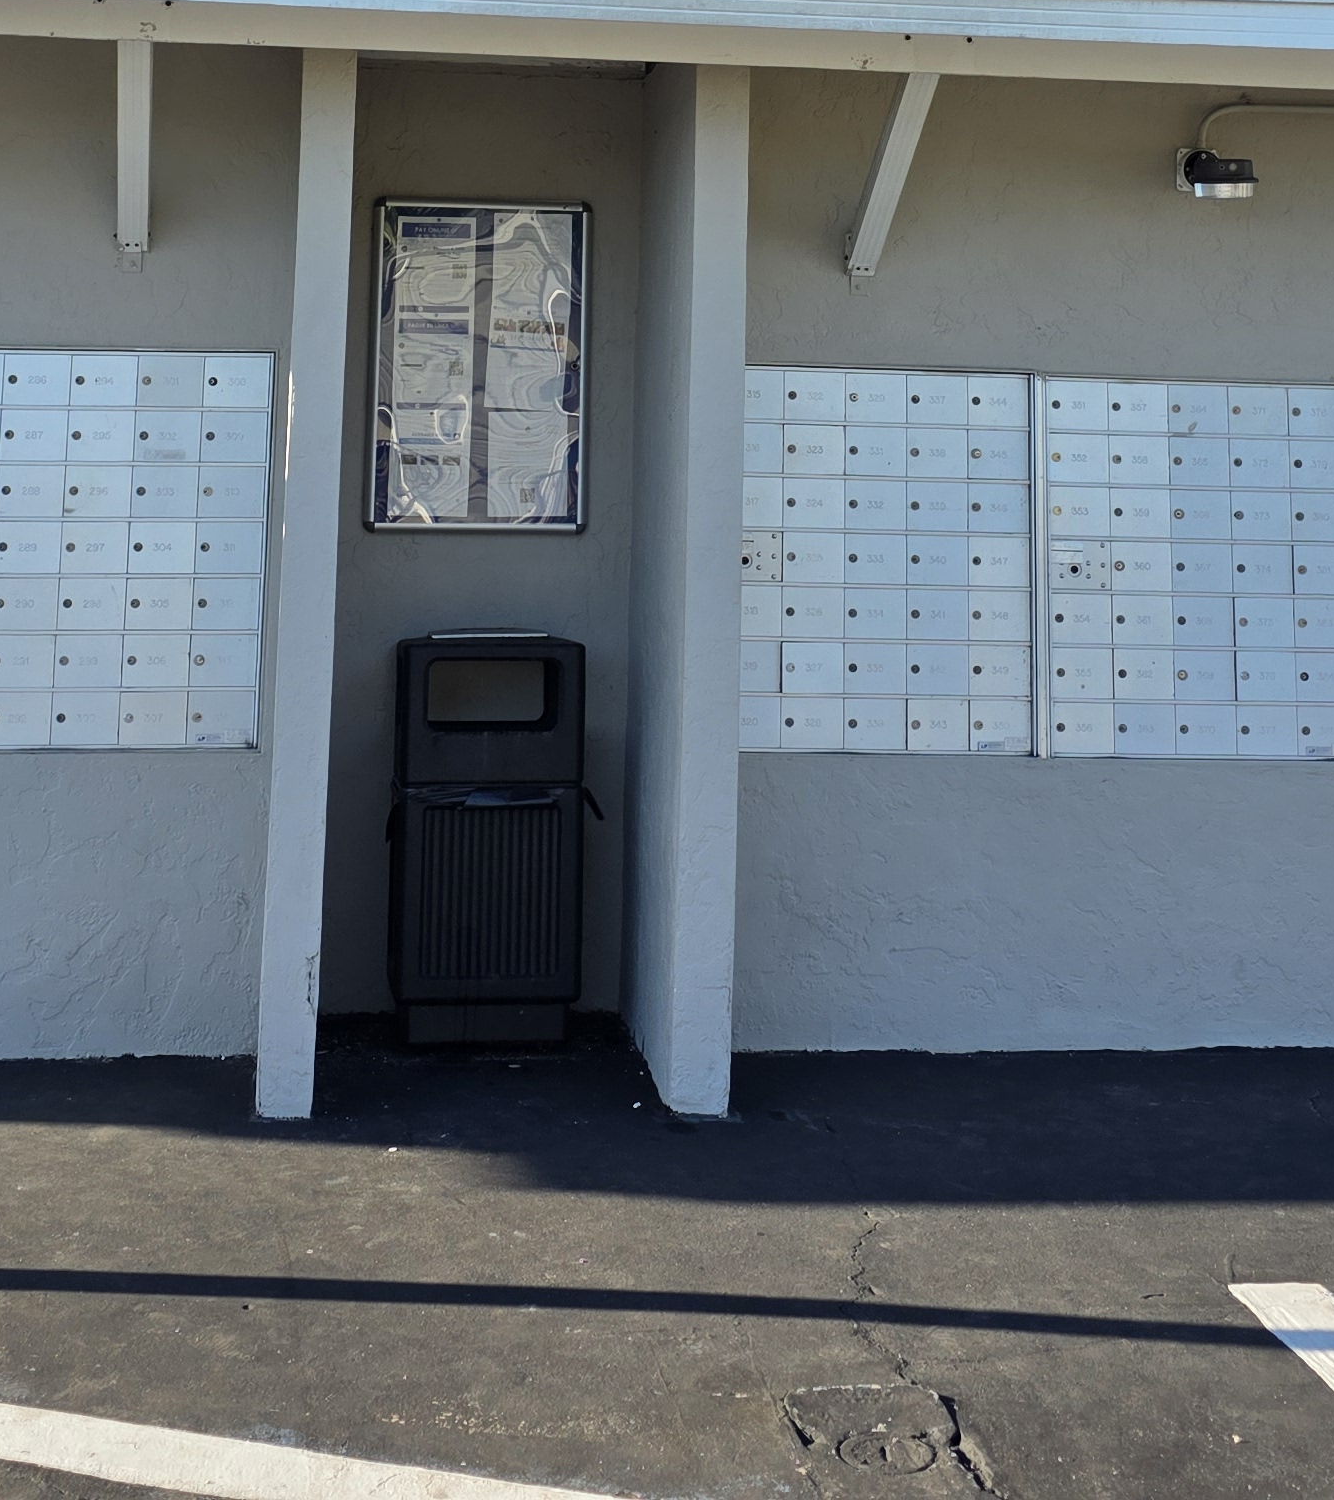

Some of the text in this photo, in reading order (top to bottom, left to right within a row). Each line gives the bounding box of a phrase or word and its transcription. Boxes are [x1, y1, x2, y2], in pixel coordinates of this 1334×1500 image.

[27, 374, 48, 385] 286
[747, 389, 762, 400] 315
[928, 395, 946, 405] 337
[988, 397, 1008, 407] 344
[1071, 400, 1086, 410] 351
[24, 430, 44, 440] 287
[806, 444, 824, 455] 323
[1070, 453, 1088, 463] 352
[21, 485, 41, 497] 288
[88, 486, 109, 497] 296
[746, 496, 760, 505] 317
[805, 498, 824, 508] 324
[866, 499, 885, 510] 332
[1070, 506, 1090, 516] 353
[17, 542, 38, 553] 289
[85, 542, 106, 553] 297
[152, 542, 173, 552] 304
[222, 542, 236, 553] 311
[866, 553, 885, 564] 333
[990, 556, 1009, 566] 347
[1133, 561, 1152, 571] 360
[149, 598, 170, 609] 305
[146, 655, 167, 666] 306
[805, 662, 823, 673] 327
[991, 665, 1010, 675] 349
[144, 713, 164, 724] 307
[740, 716, 759, 727] 320
[929, 719, 948, 730] 343
